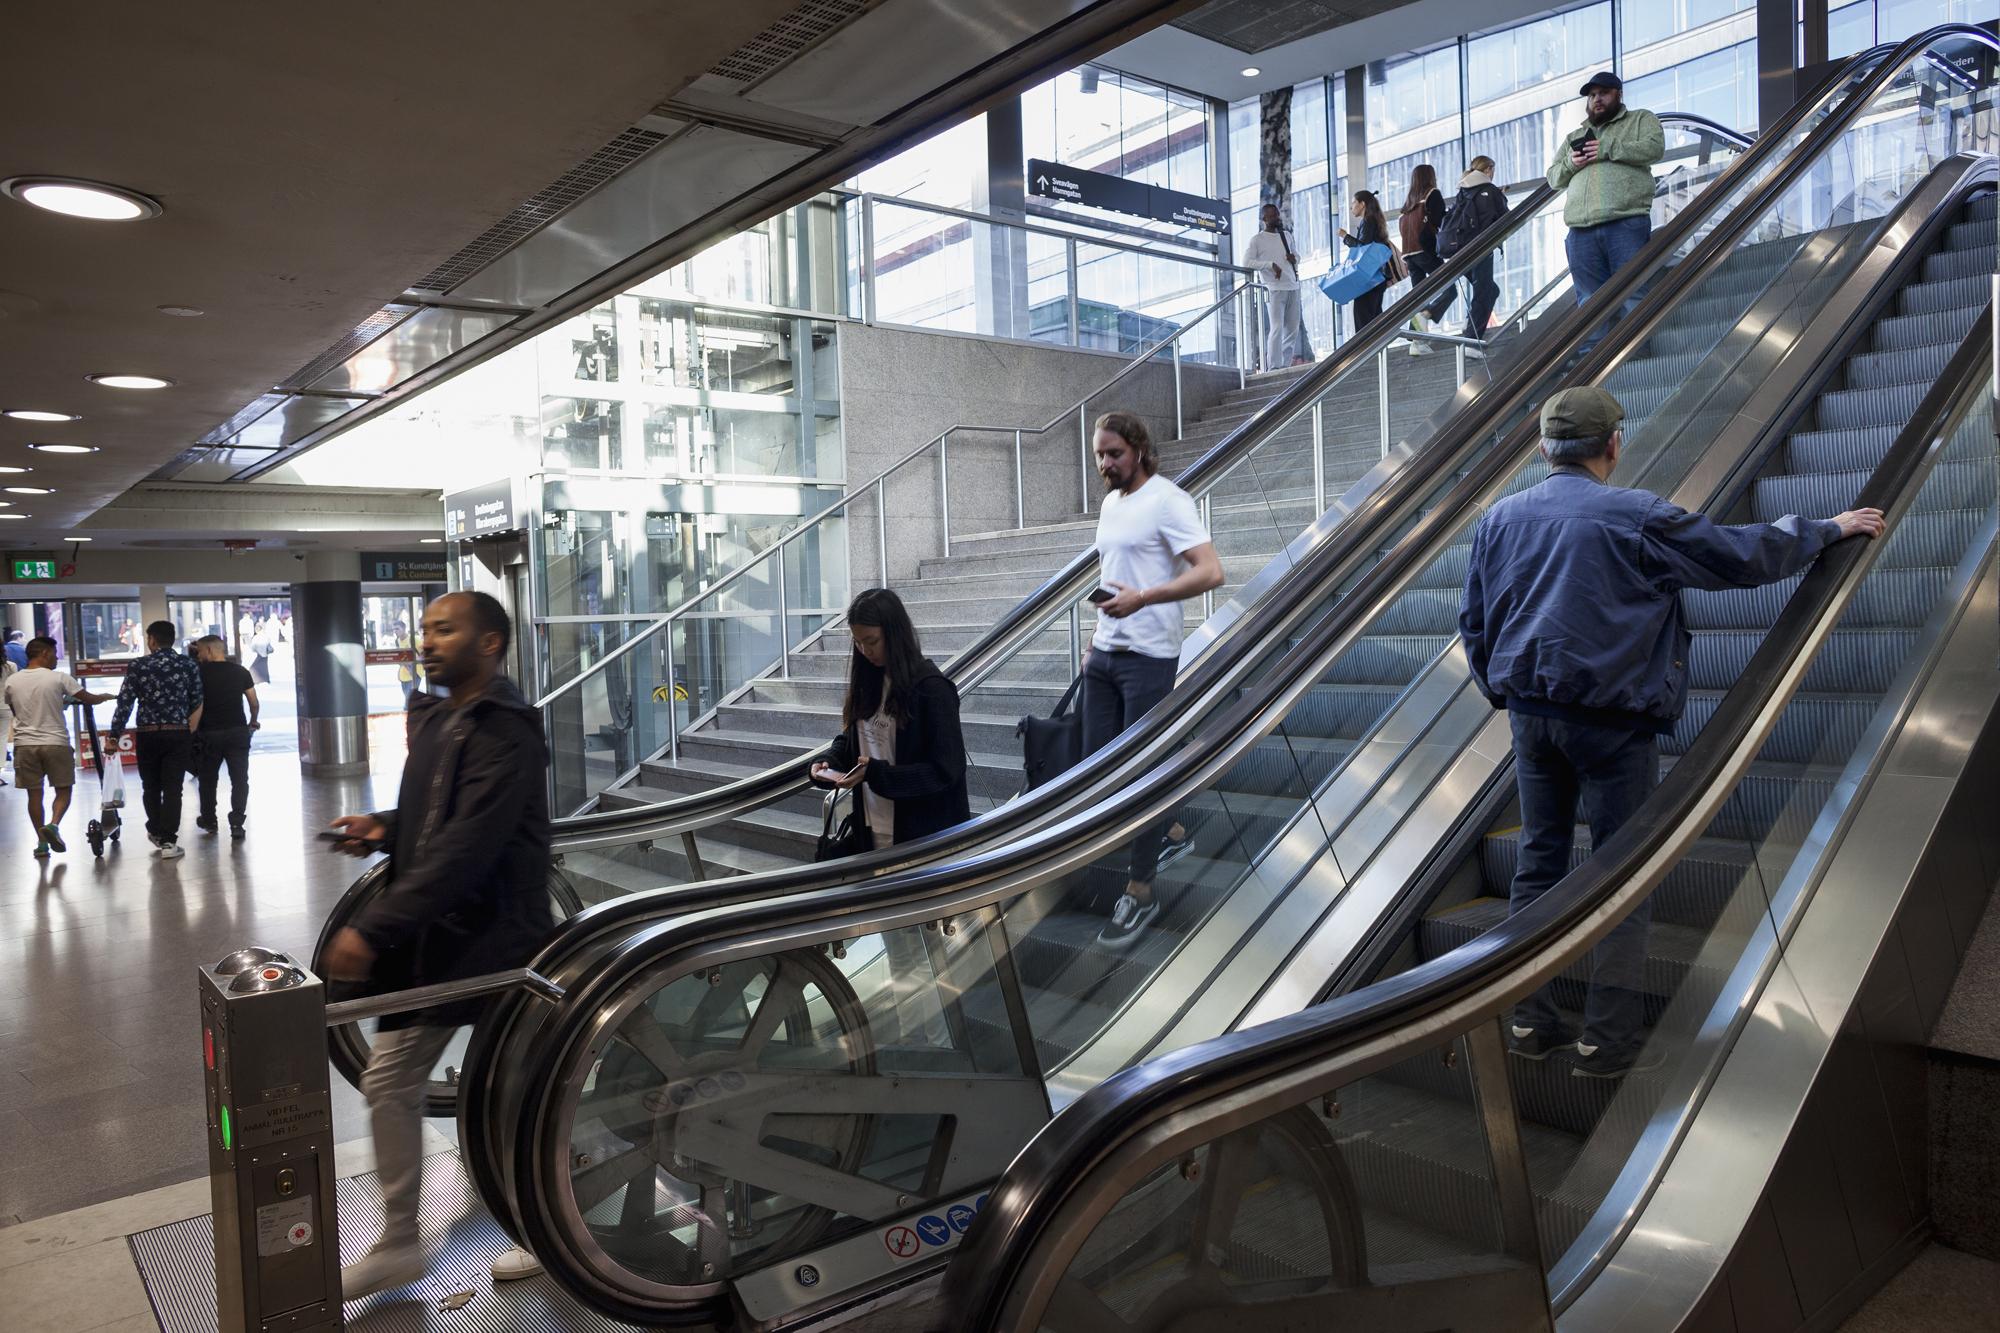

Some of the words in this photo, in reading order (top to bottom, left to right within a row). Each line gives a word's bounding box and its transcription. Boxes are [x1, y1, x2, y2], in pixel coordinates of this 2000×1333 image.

[1052, 177, 1079, 190] Sveavägen
[1052, 185, 1081, 199] Hamngatan
[1172, 212, 1187, 222] Gamla
[1197, 217, 1205, 226] Old
[1183, 206, 1216, 220] Drottninggatan
[397, 562, 408, 570] SL
[464, 564, 471, 581] R
[398, 571, 408, 579] SL
[409, 571, 443, 579] Customer
[266, 1107, 282, 1117] VID
[284, 1104, 301, 1113] FEL
[274, 1109, 325, 1126] RULLTRAPPA
[271, 1127, 285, 1137] NR
[287, 1124, 298, 1133] 15
